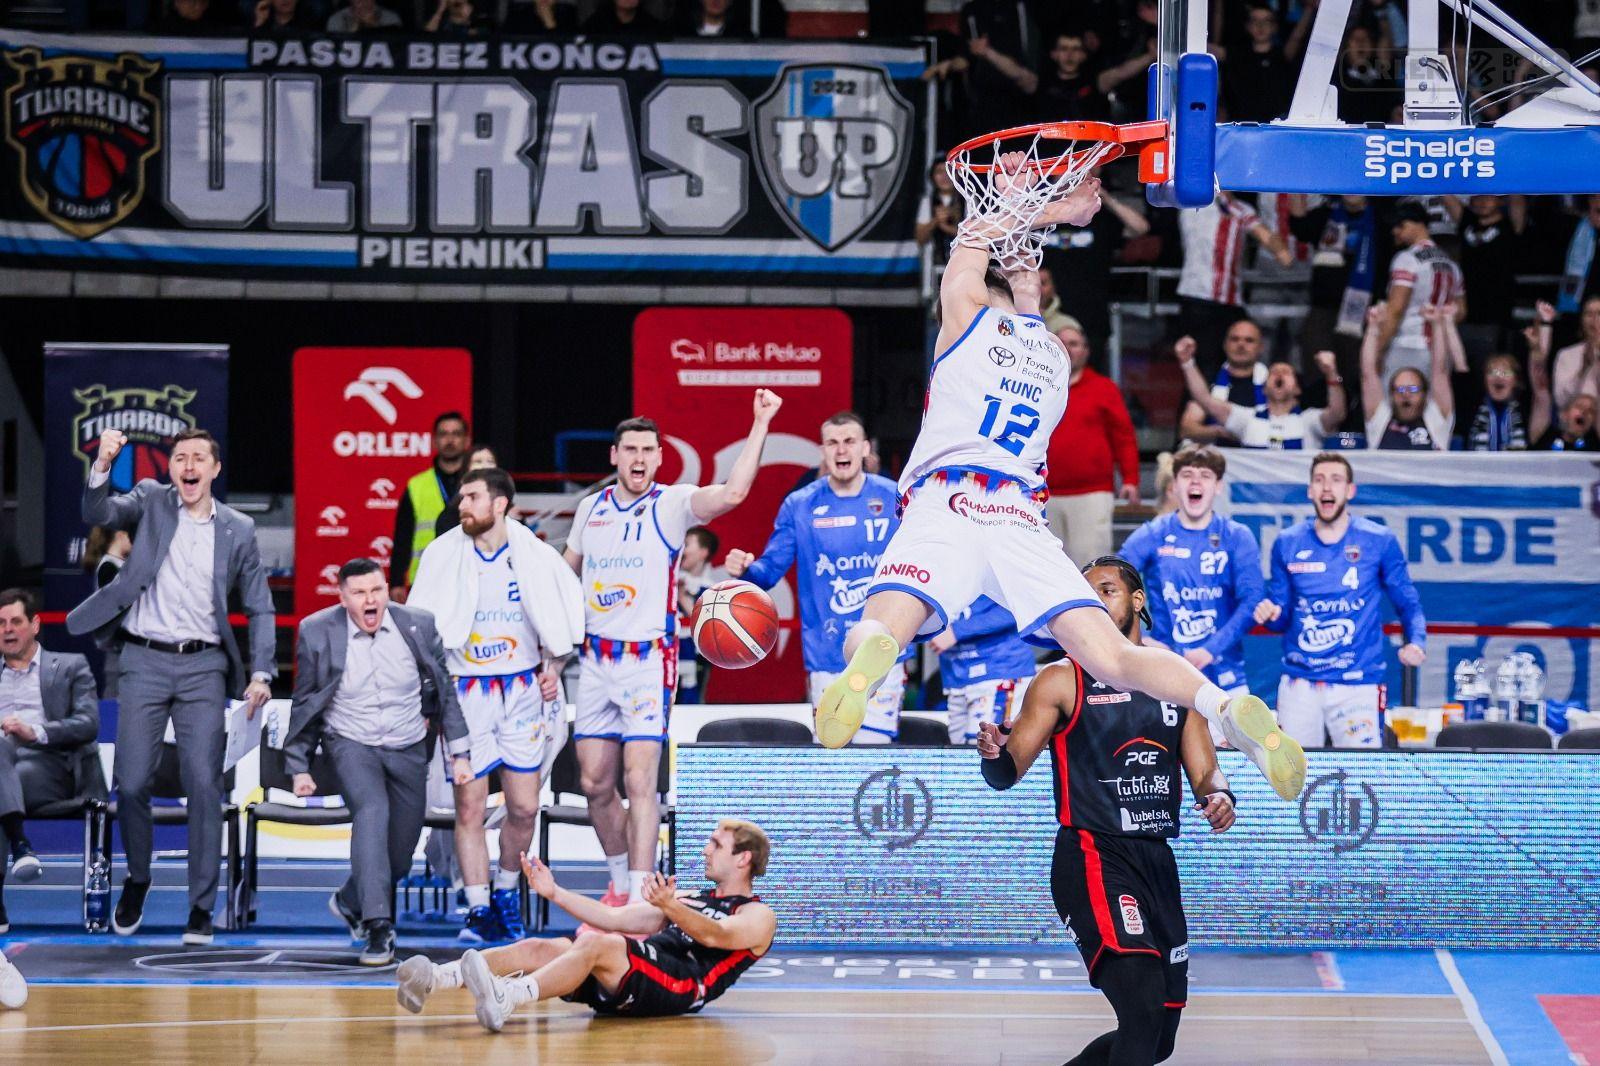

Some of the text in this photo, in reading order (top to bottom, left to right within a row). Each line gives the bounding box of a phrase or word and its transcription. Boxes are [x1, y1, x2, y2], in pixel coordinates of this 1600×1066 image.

[251, 36, 659, 72] PASJA BEZ KOŃCA
[14, 86, 150, 134] TWARDE
[164, 73, 749, 236] ULTRAS
[771, 117, 900, 200] UP
[1365, 134, 1496, 158] Schelde
[1364, 156, 1496, 184] Sports
[361, 238, 544, 270] PIERNIKI
[714, 342, 821, 362] Bank Pekao
[1025, 356, 1054, 375] Toyota
[999, 376, 1042, 403] KUNC
[978, 394, 1041, 458] 12
[332, 431, 433, 458] ORLEN
[959, 497, 1039, 527] AutoAndreas
[623, 521, 642, 541] 11
[863, 517, 889, 542] 17
[1230, 514, 1557, 566] TRDE
[599, 555, 644, 569] arriva
[879, 563, 931, 584] ANIRO
[1199, 550, 1229, 575] 27
[1341, 566, 1359, 590] 4
[1160, 701, 1178, 726] 6
[1124, 751, 1159, 766] PGE
